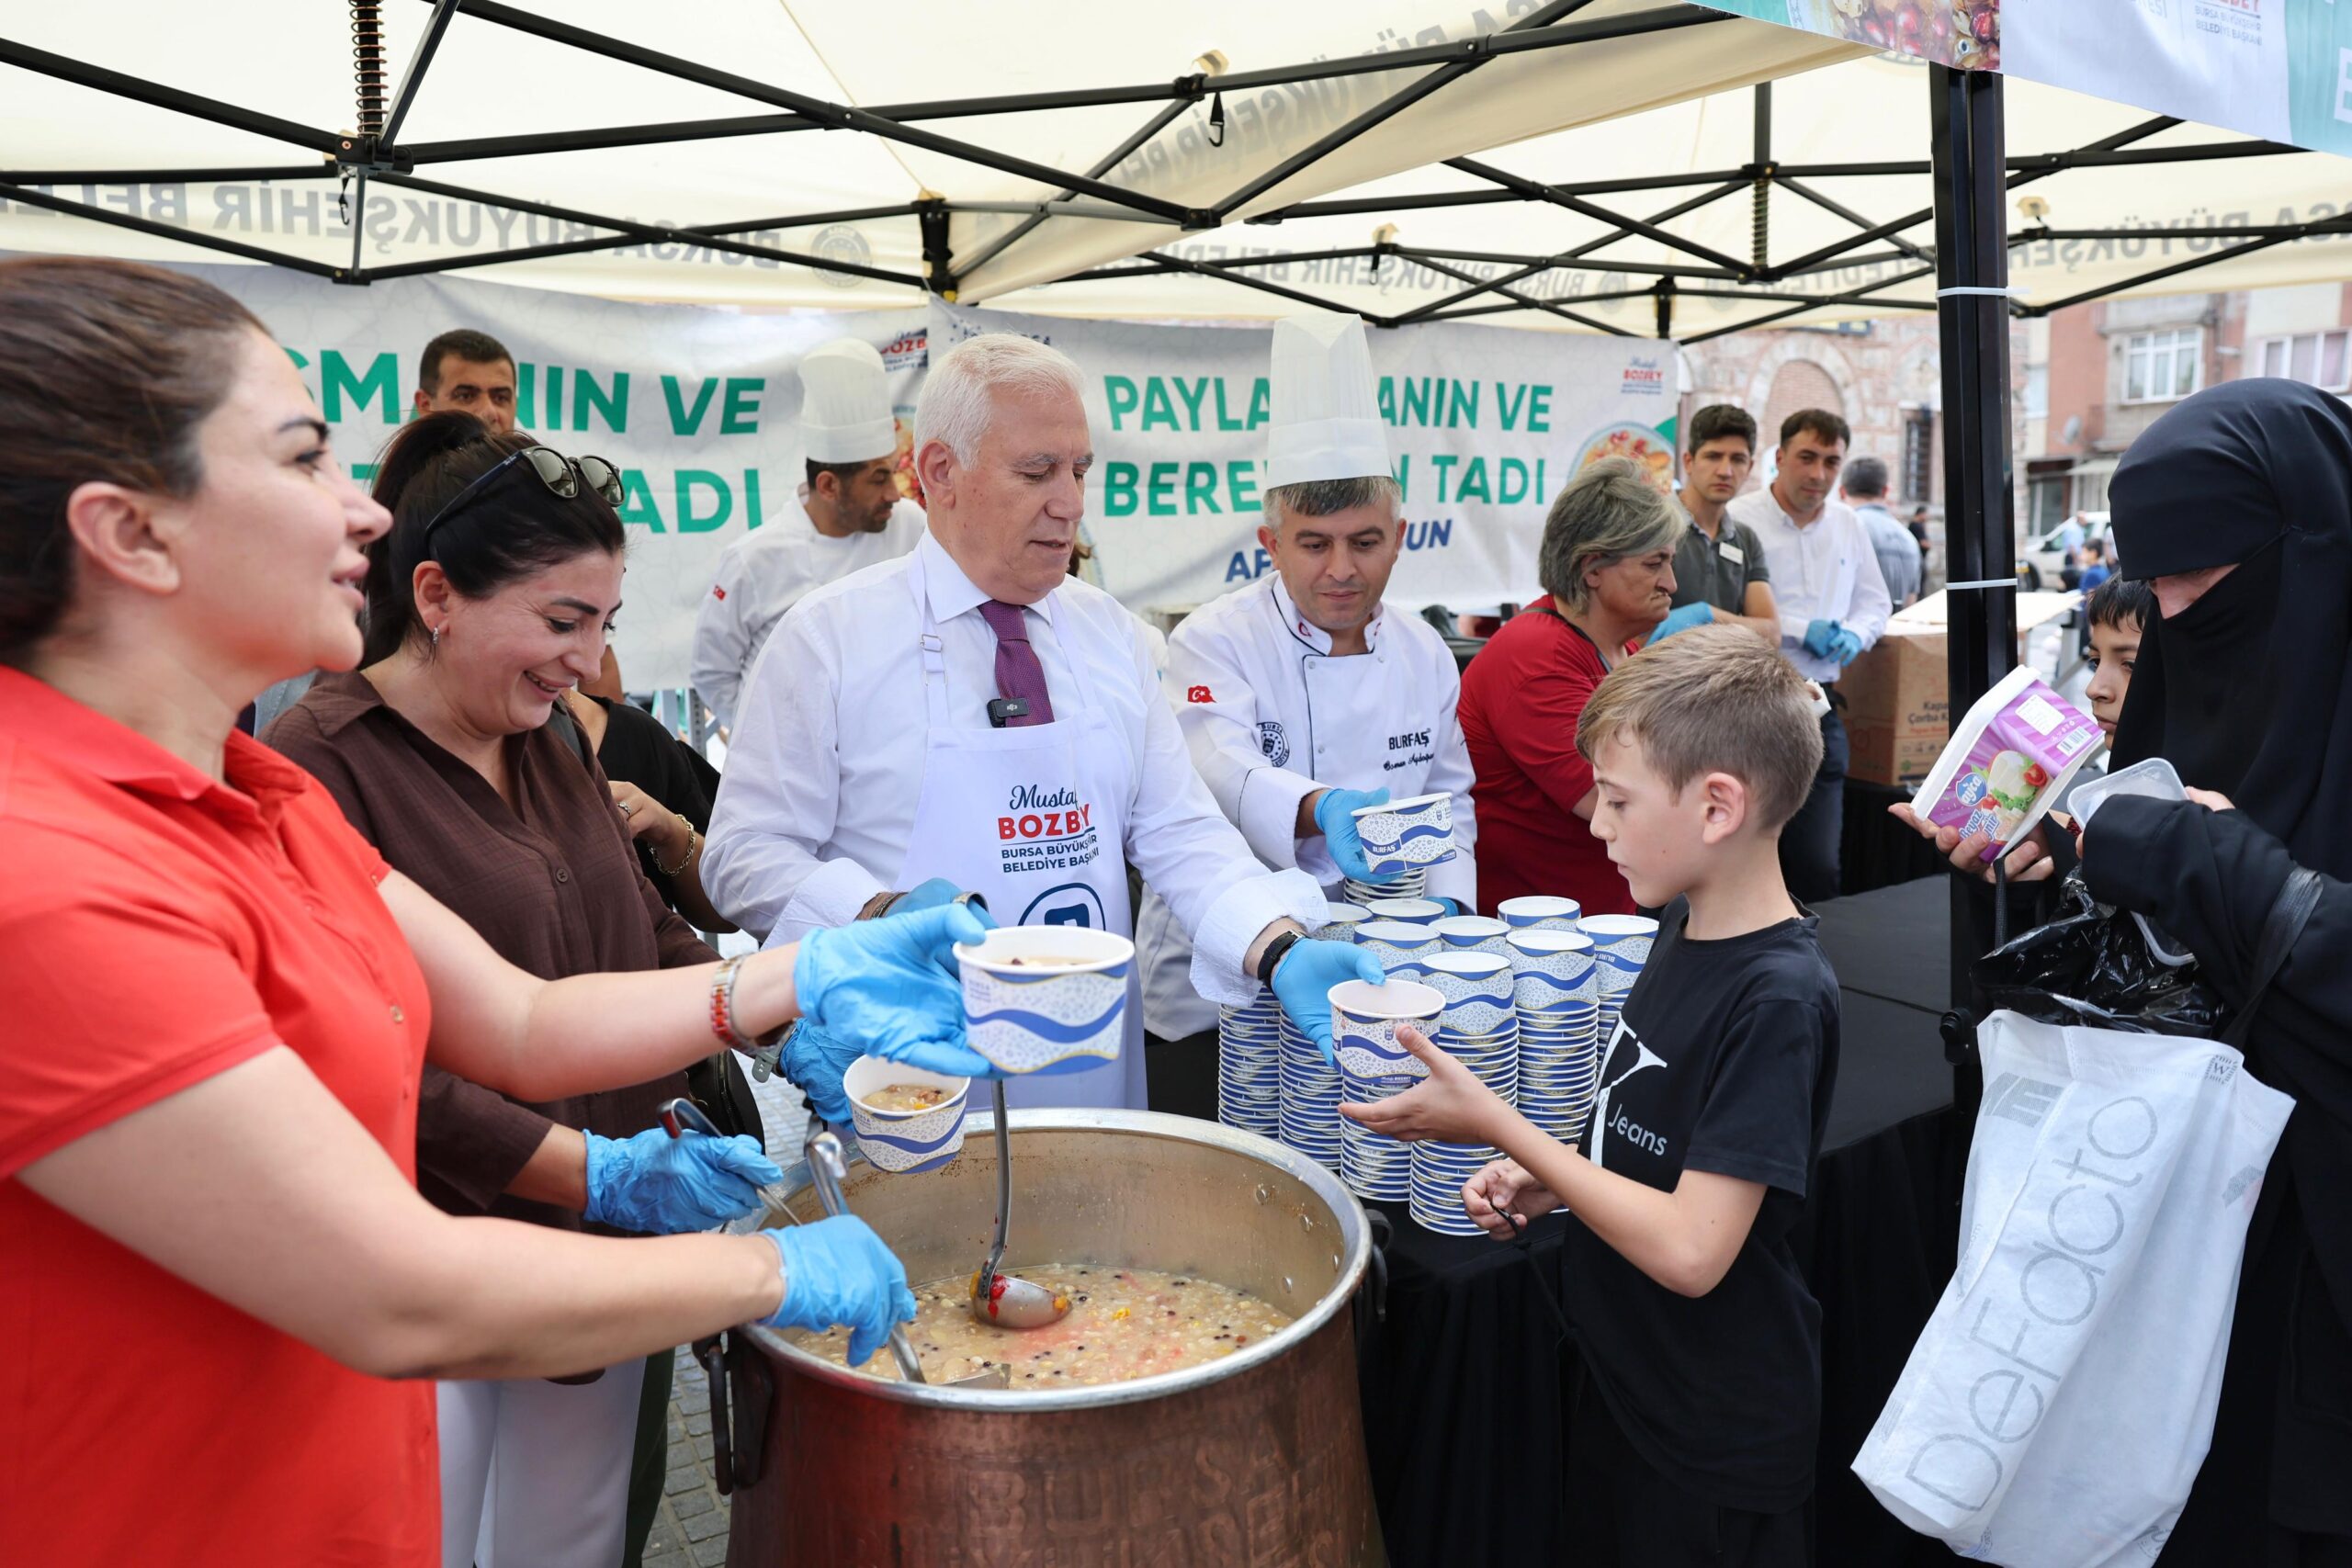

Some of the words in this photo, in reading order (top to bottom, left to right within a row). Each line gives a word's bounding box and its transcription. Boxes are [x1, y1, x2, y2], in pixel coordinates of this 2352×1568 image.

[661, 375, 766, 436] VE
[1496, 383, 1554, 433] VE
[619, 468, 762, 534] ADI
[1431, 456, 1545, 505] TADI
[1388, 732, 1430, 750] BURFAŞ
[998, 803, 1091, 840] BOZBY
[1001, 846, 1044, 859] BURSA
[1002, 857, 1066, 873] BELEDİYE
[1608, 1103, 1668, 1156] Jeans
[1905, 1096, 2157, 1513] DeFacto
